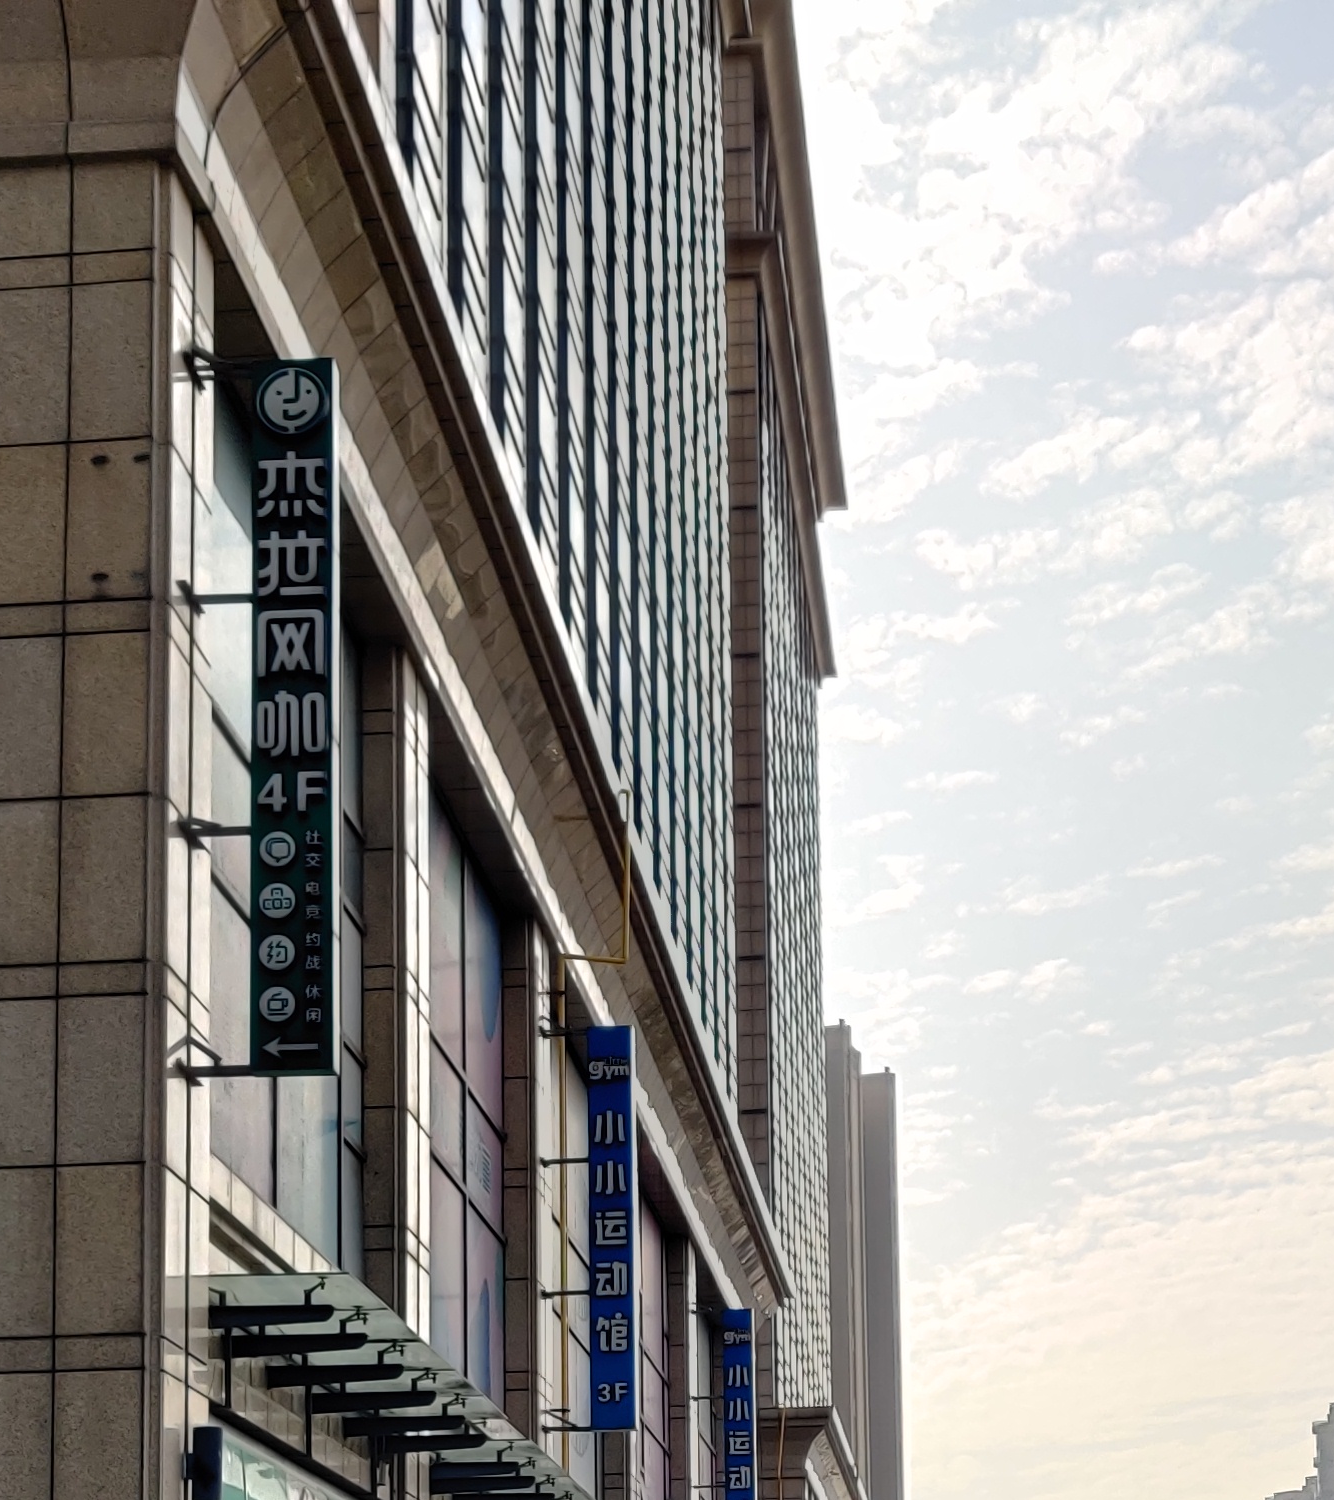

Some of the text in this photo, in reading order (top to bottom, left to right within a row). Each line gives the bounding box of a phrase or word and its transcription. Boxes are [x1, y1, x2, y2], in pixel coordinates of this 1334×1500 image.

[256, 451, 327, 758] 杰拉网咖
[256, 770, 328, 812] 4F
[305, 880, 321, 919] 电竞
[305, 932, 321, 970] 约战
[594, 1110, 628, 1353] 小小运动馆
[597, 1381, 629, 1403] 3F
